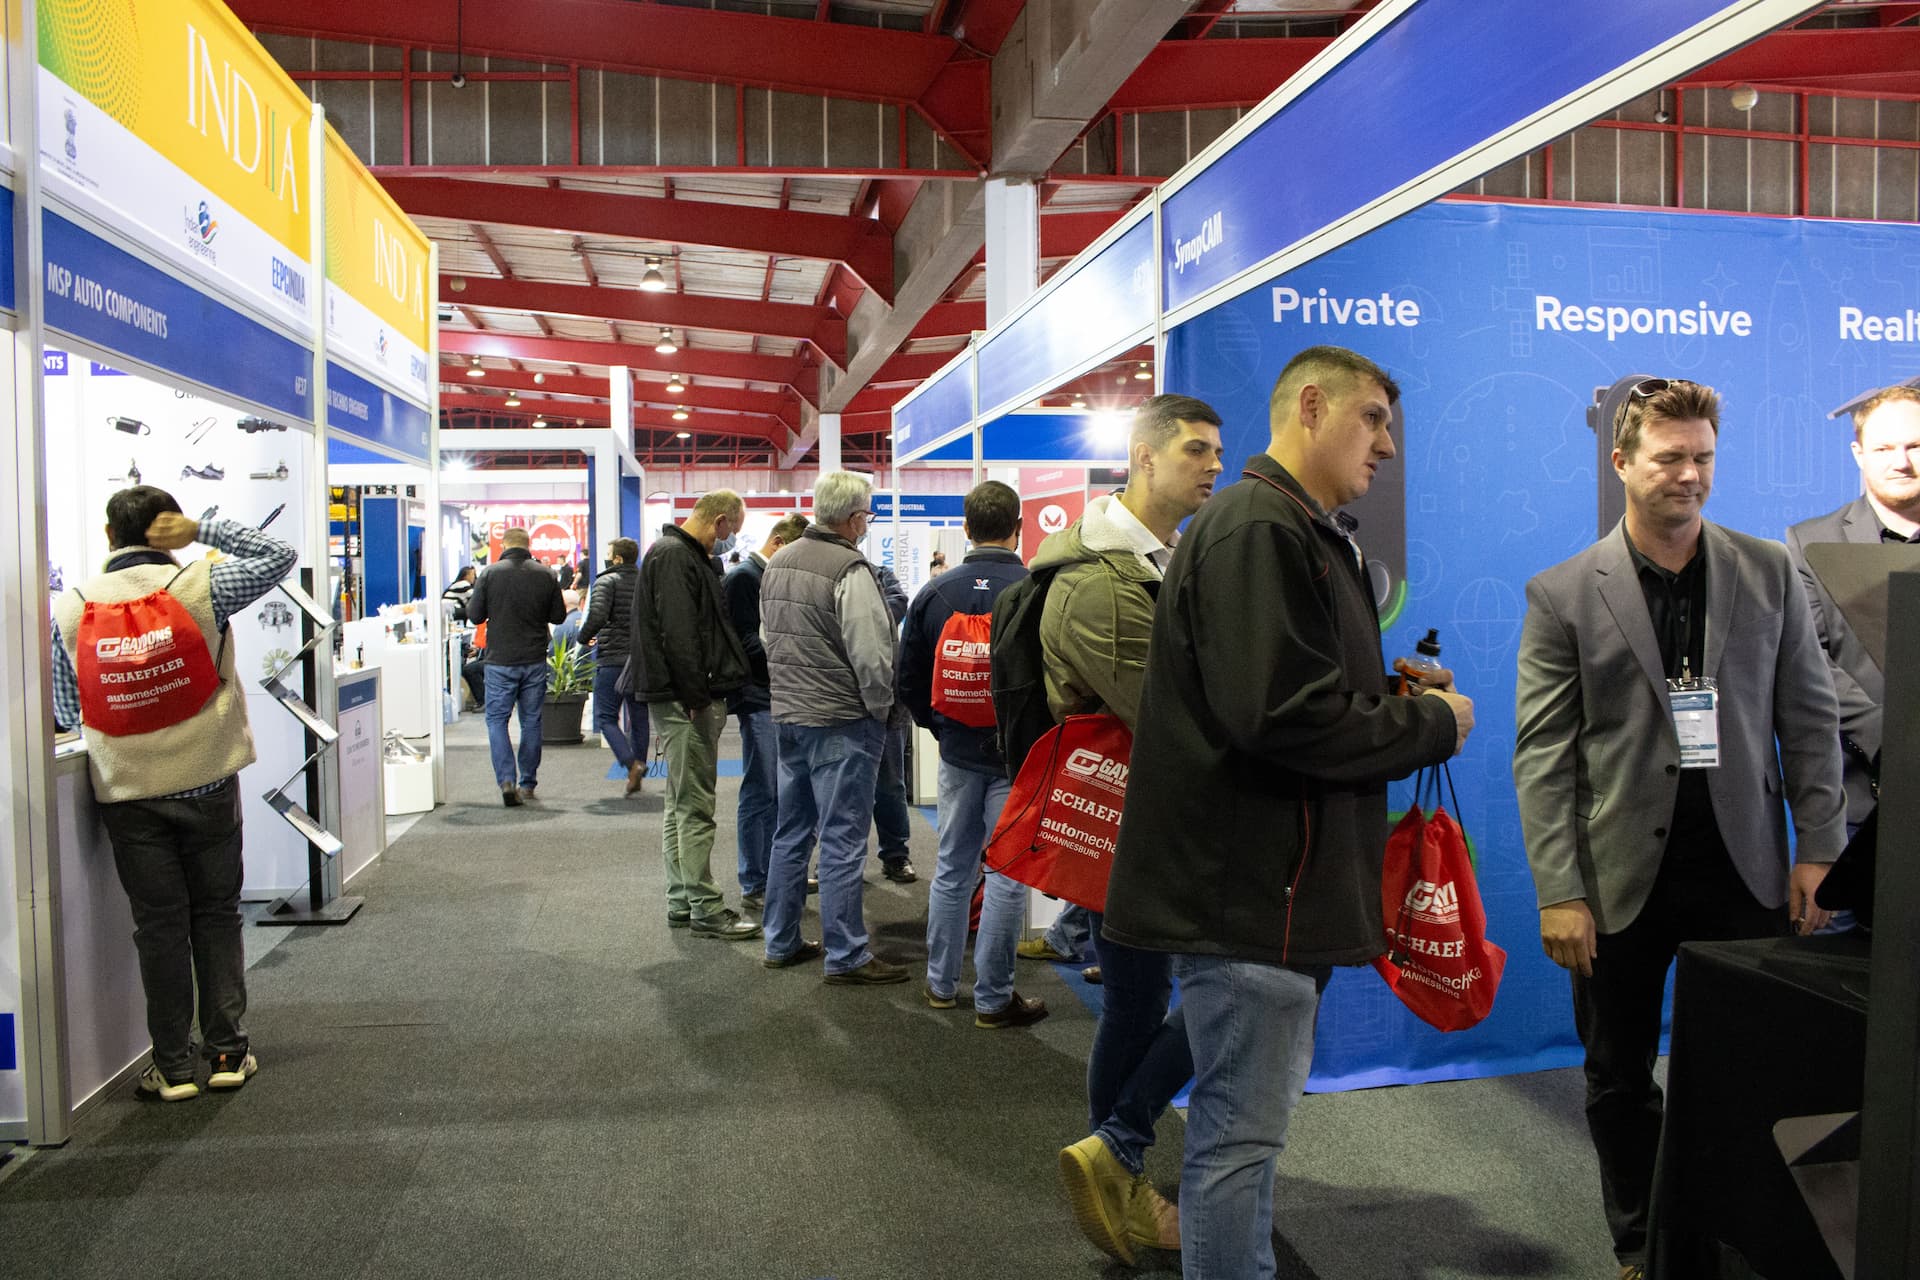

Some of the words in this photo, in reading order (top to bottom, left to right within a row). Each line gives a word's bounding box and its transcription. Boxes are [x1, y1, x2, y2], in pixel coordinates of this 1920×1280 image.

[187, 23, 299, 214] INDIA
[1174, 210, 1223, 274] SynapCAM
[47, 262, 72, 298] MSP
[74, 274, 103, 312] AUTO
[105, 288, 168, 340] COMPONENTS
[1272, 286, 1421, 327] Private
[1535, 295, 1753, 341] Responsive
[43, 355, 64, 370] NTS
[899, 529, 909, 594] DUSTRIAL
[100, 657, 185, 684] SCHAEFFLER
[106, 676, 191, 702] automechanika
[942, 668, 991, 681] SCHAEFF
[944, 687, 991, 698] automech
[1050, 788, 1123, 826] SCHAEF
[1037, 831, 1100, 860] JOHANNESBURG
[1040, 817, 1117, 854] automecha
